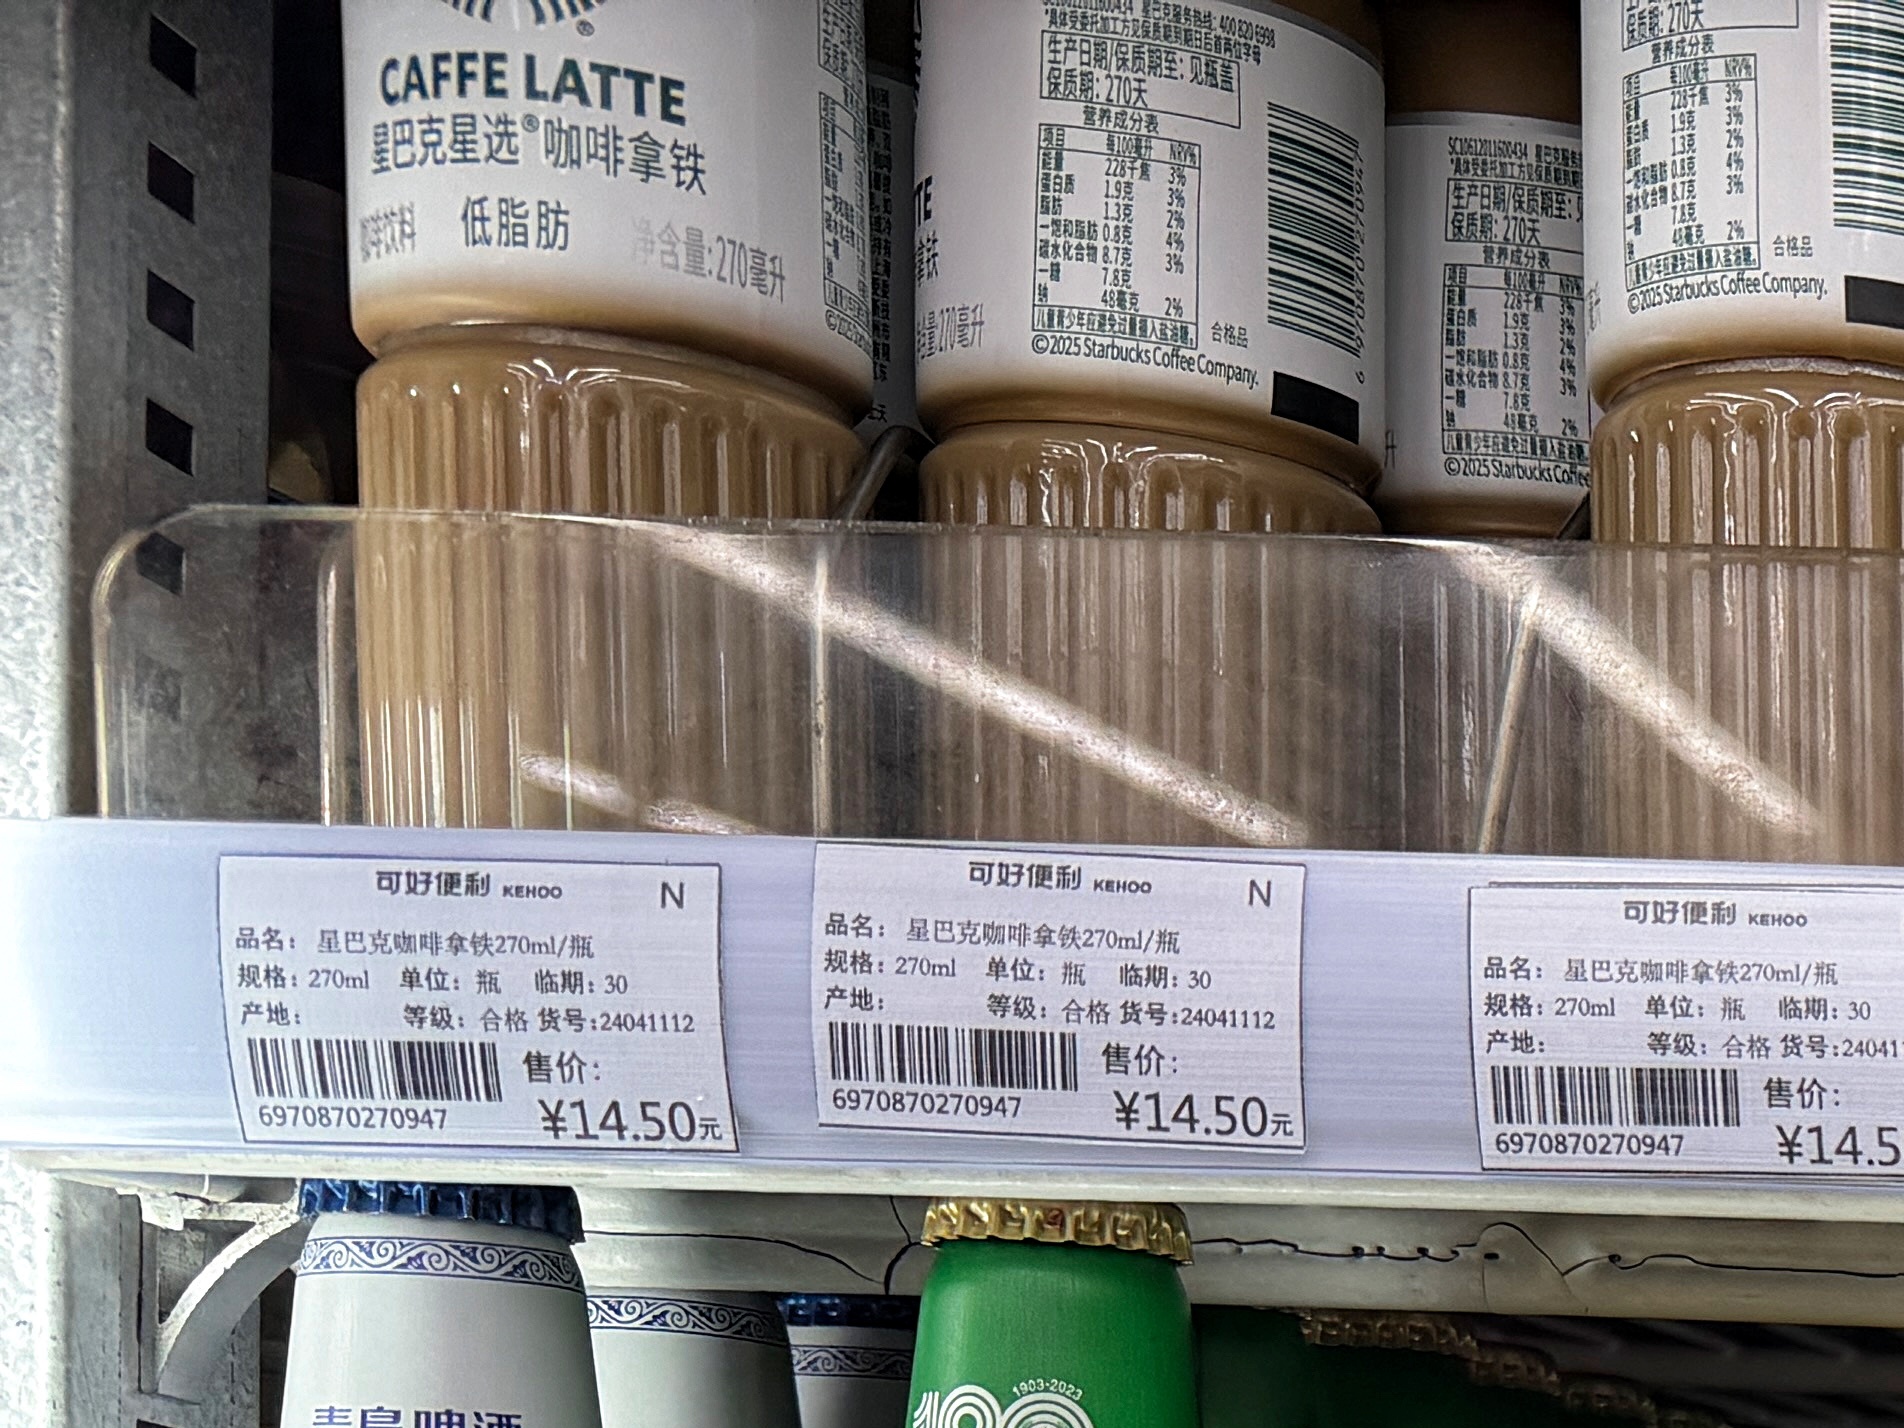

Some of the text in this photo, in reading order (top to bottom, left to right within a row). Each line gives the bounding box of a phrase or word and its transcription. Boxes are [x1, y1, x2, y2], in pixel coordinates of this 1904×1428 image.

[380, 51, 686, 127] CAFFE LATTE
[1082, 105, 1160, 134] 营养成分表
[461, 196, 570, 252] 低脂肪
[1773, 234, 1813, 258] 合格品
[1211, 323, 1249, 349] 合格品
[1083, 338, 1151, 366] Starbucks
[1153, 347, 1195, 372] Coffee
[375, 870, 491, 898] 可好便利
[1623, 899, 1737, 927] 可好便利
[258, 1106, 448, 1131] 6970870270947
[539, 1097, 723, 1142] ¥14.50元
[1113, 1089, 1295, 1138] ¥14.50元
[1495, 1133, 1684, 1156] 6970870270947
[1012, 1378, 1083, 1401] 1903-2023
